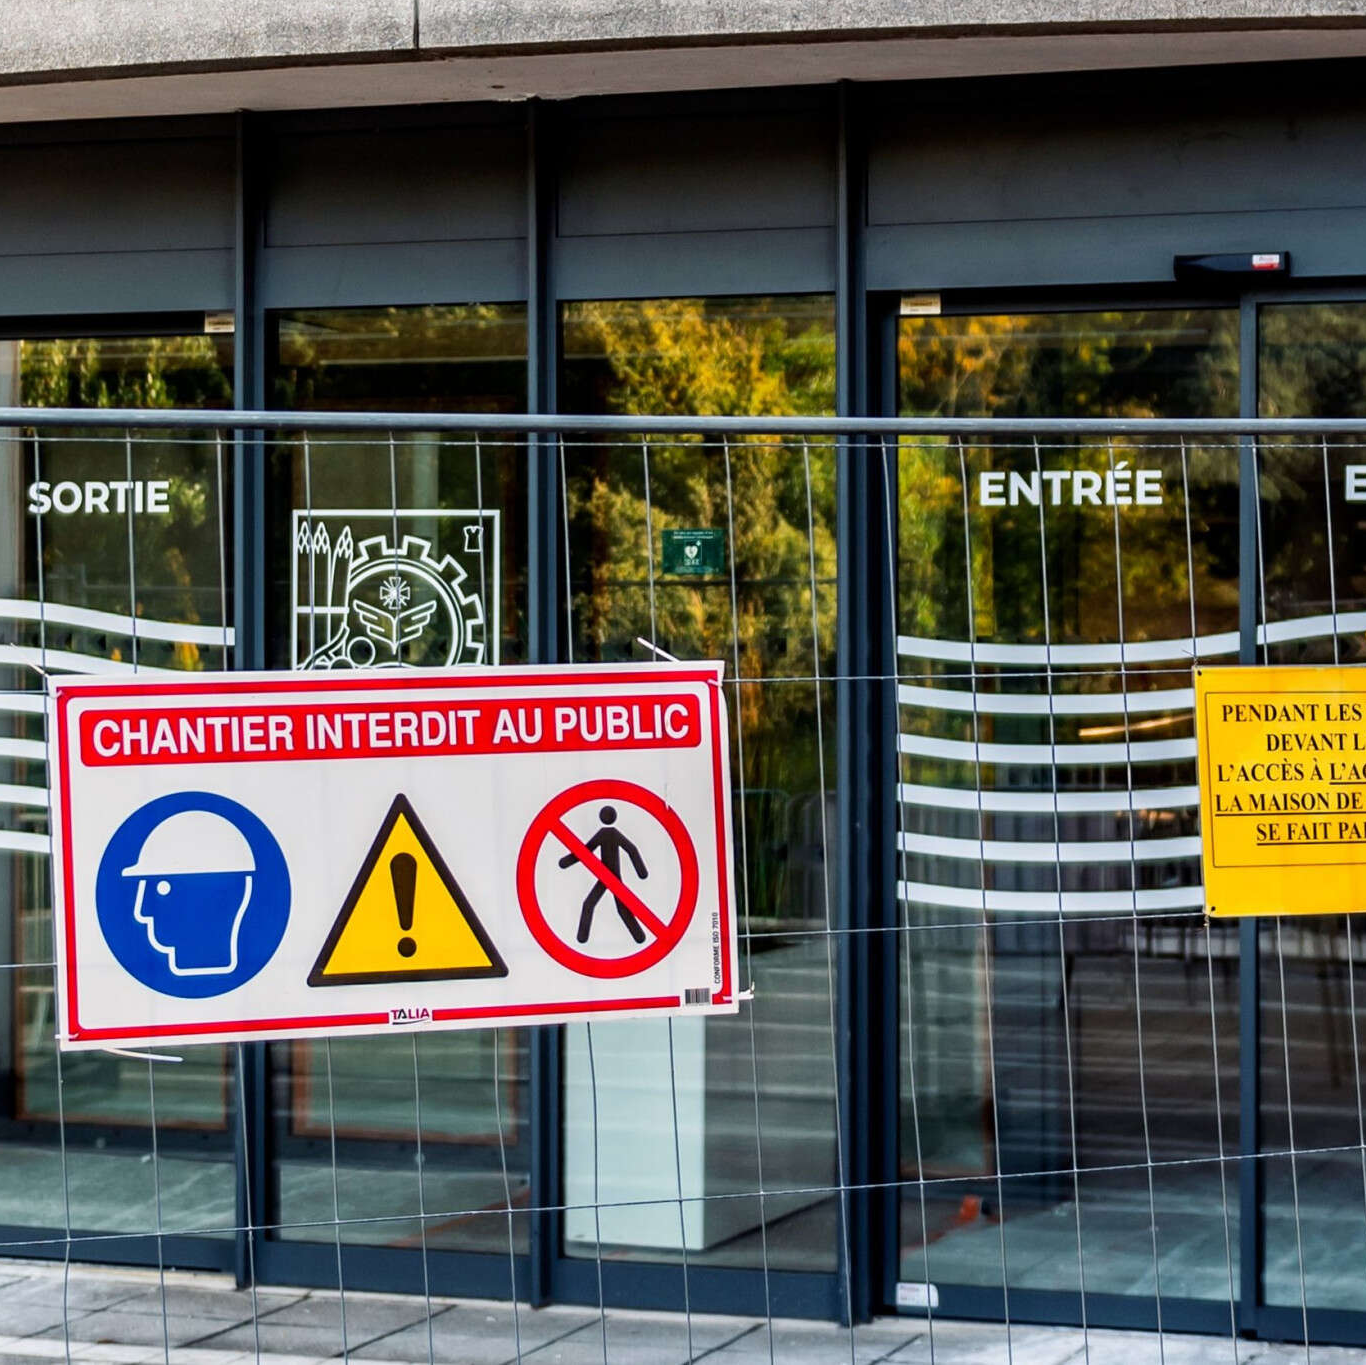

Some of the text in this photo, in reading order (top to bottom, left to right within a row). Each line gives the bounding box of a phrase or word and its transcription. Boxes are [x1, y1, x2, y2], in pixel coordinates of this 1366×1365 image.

[979, 460, 1163, 507] ENTRÉE
[28, 481, 170, 515] SORTIE
[1222, 704, 1319, 722] PENDANT
[1325, 703, 1362, 722] LES
[93, 703, 689, 757] CHANTIER INTERDIT AU PUBLIC
[1267, 733, 1347, 752] DEVANT
[1218, 757, 1304, 782] L'ACCÈS
[1310, 756, 1324, 781] À
[1215, 793, 1243, 812] LA
[1248, 792, 1330, 812] MAISON
[1336, 791, 1364, 810] DE
[1256, 823, 1281, 841] SE
[1286, 822, 1333, 841] FAIT
[711, 912, 719, 929] 7010
[713, 946, 721, 984] CONFORME
[390, 1007, 430, 1020] TALIA
